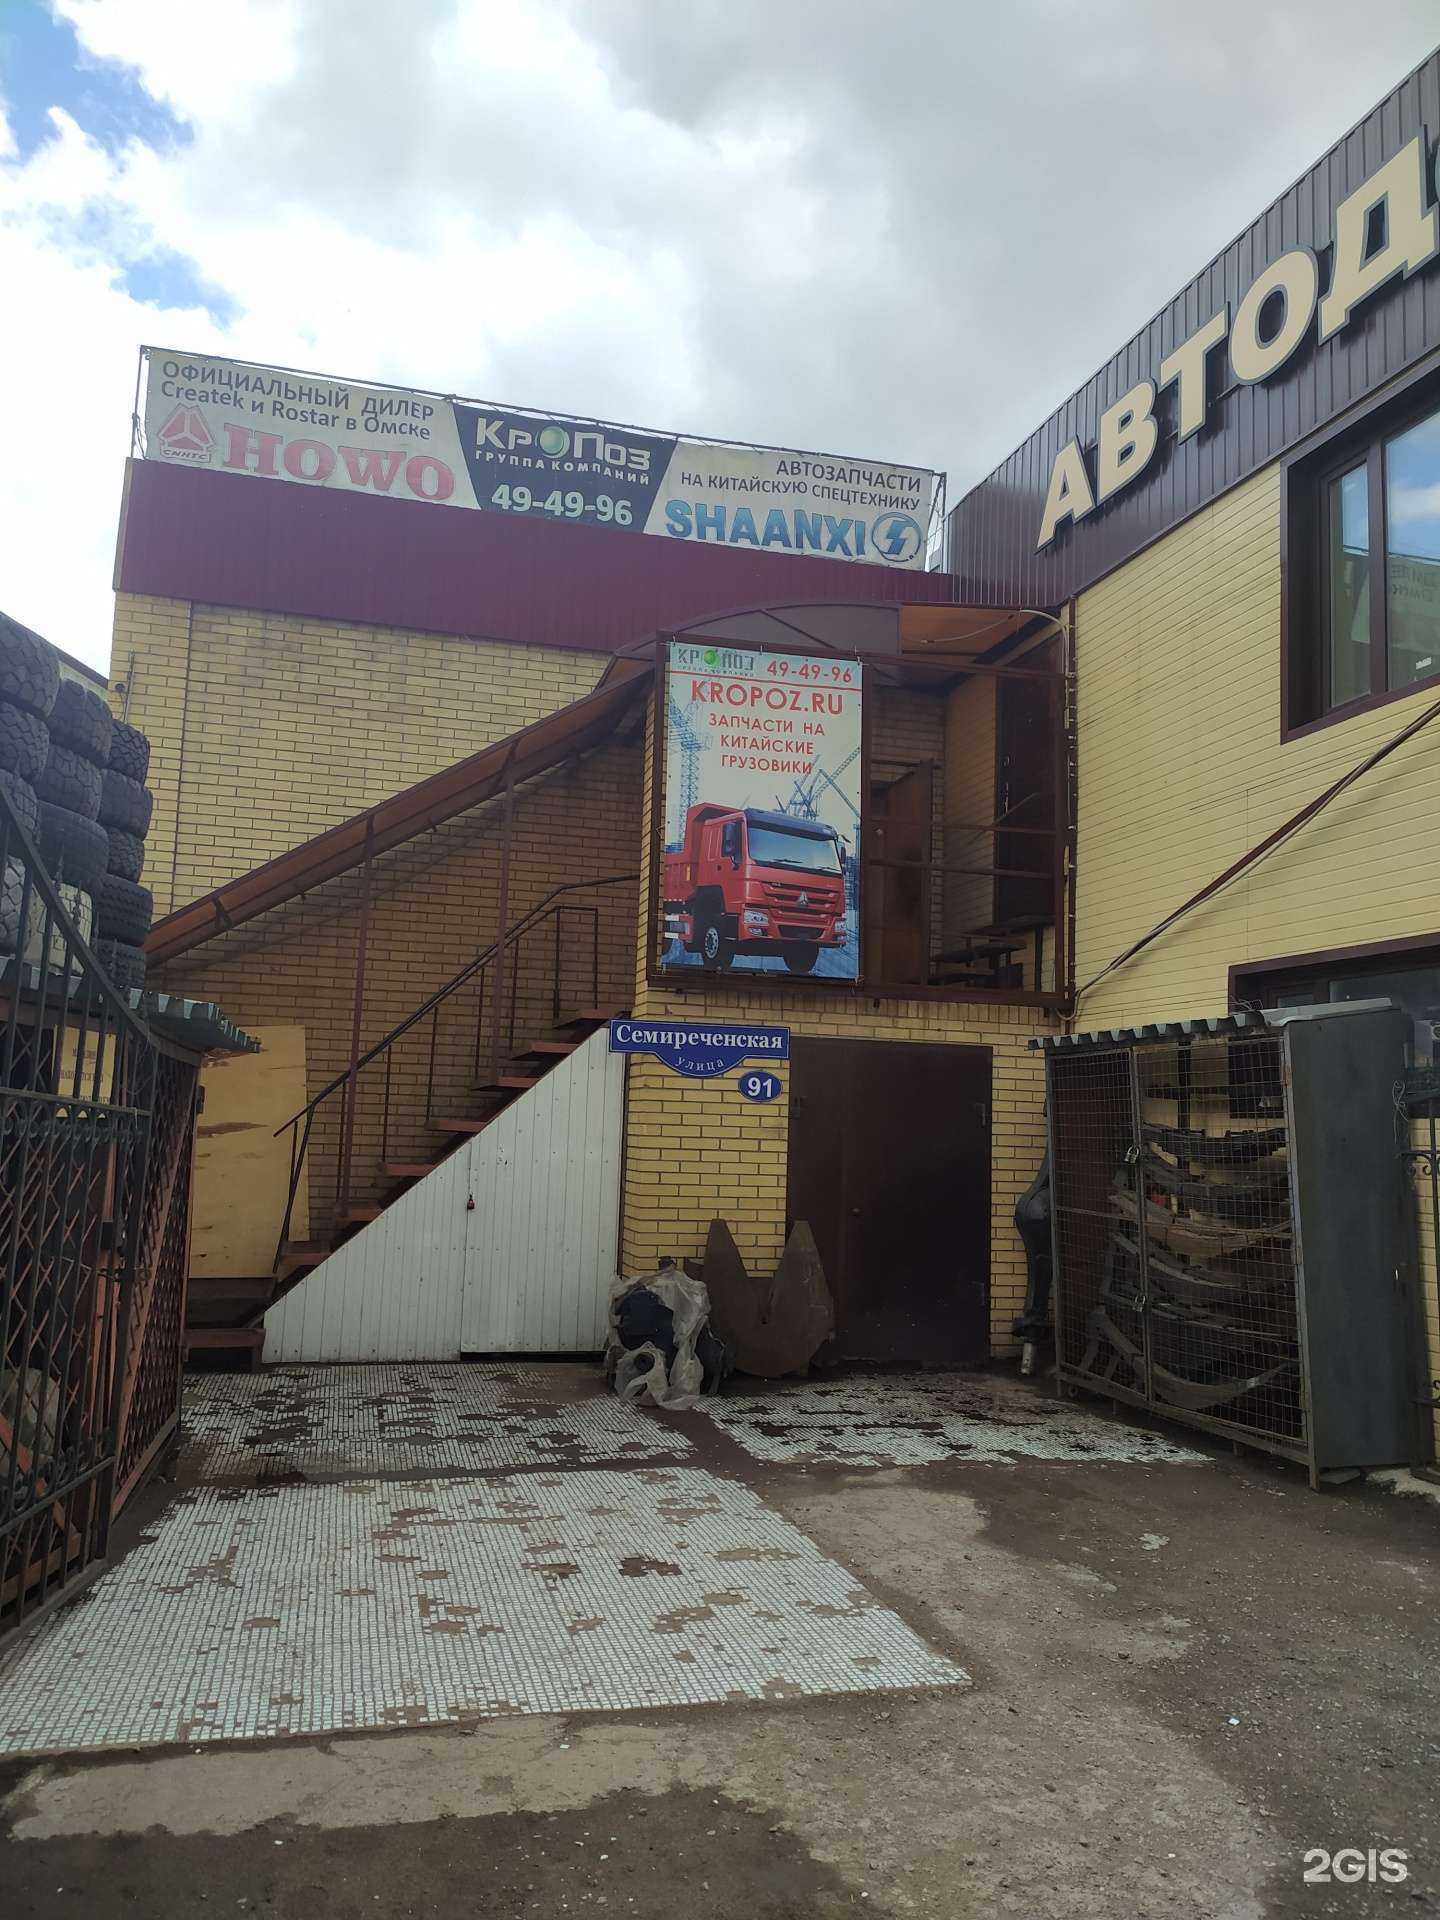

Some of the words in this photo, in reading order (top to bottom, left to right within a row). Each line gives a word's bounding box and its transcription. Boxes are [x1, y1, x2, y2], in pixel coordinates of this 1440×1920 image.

[1035, 128, 1440, 553] АВТОД
[162, 360, 350, 410] ОФИЦИАЛЬНЫЙ
[361, 395, 434, 422] ДИЛЕР
[161, 380, 244, 409] Createk
[251, 401, 264, 415] и
[273, 401, 340, 429] Rostar
[346, 417, 356, 430] в
[363, 417, 431, 440] Омске
[223, 423, 456, 501] HOWO
[475, 449, 545, 470] ГРУППА
[551, 460, 650, 485] КОМПАНИЙ
[776, 458, 921, 493] АВТОЗАПЧАСТИ
[491, 484, 633, 526] 49-49-96
[681, 471, 704, 488] НА
[709, 473, 808, 495] КИТАЙСКУЮ
[812, 483, 921, 511] СПЕЦТЕХНИКУ
[664, 498, 866, 557] SHAANXI
[767, 660, 852, 683] 49-49-96
[691, 680, 843, 715] KROPOZ.RU
[708, 713, 793, 733] ЗАПЧАСТИ
[803, 722, 825, 736] НА
[720, 734, 814, 755] КИТАЙСКИЕ
[721, 755, 813, 775] ГРУЗОВИКИ
[616, 1025, 783, 1050] Семиреченская
[675, 1057, 724, 1072] улица
[747, 1077, 772, 1098] 91
